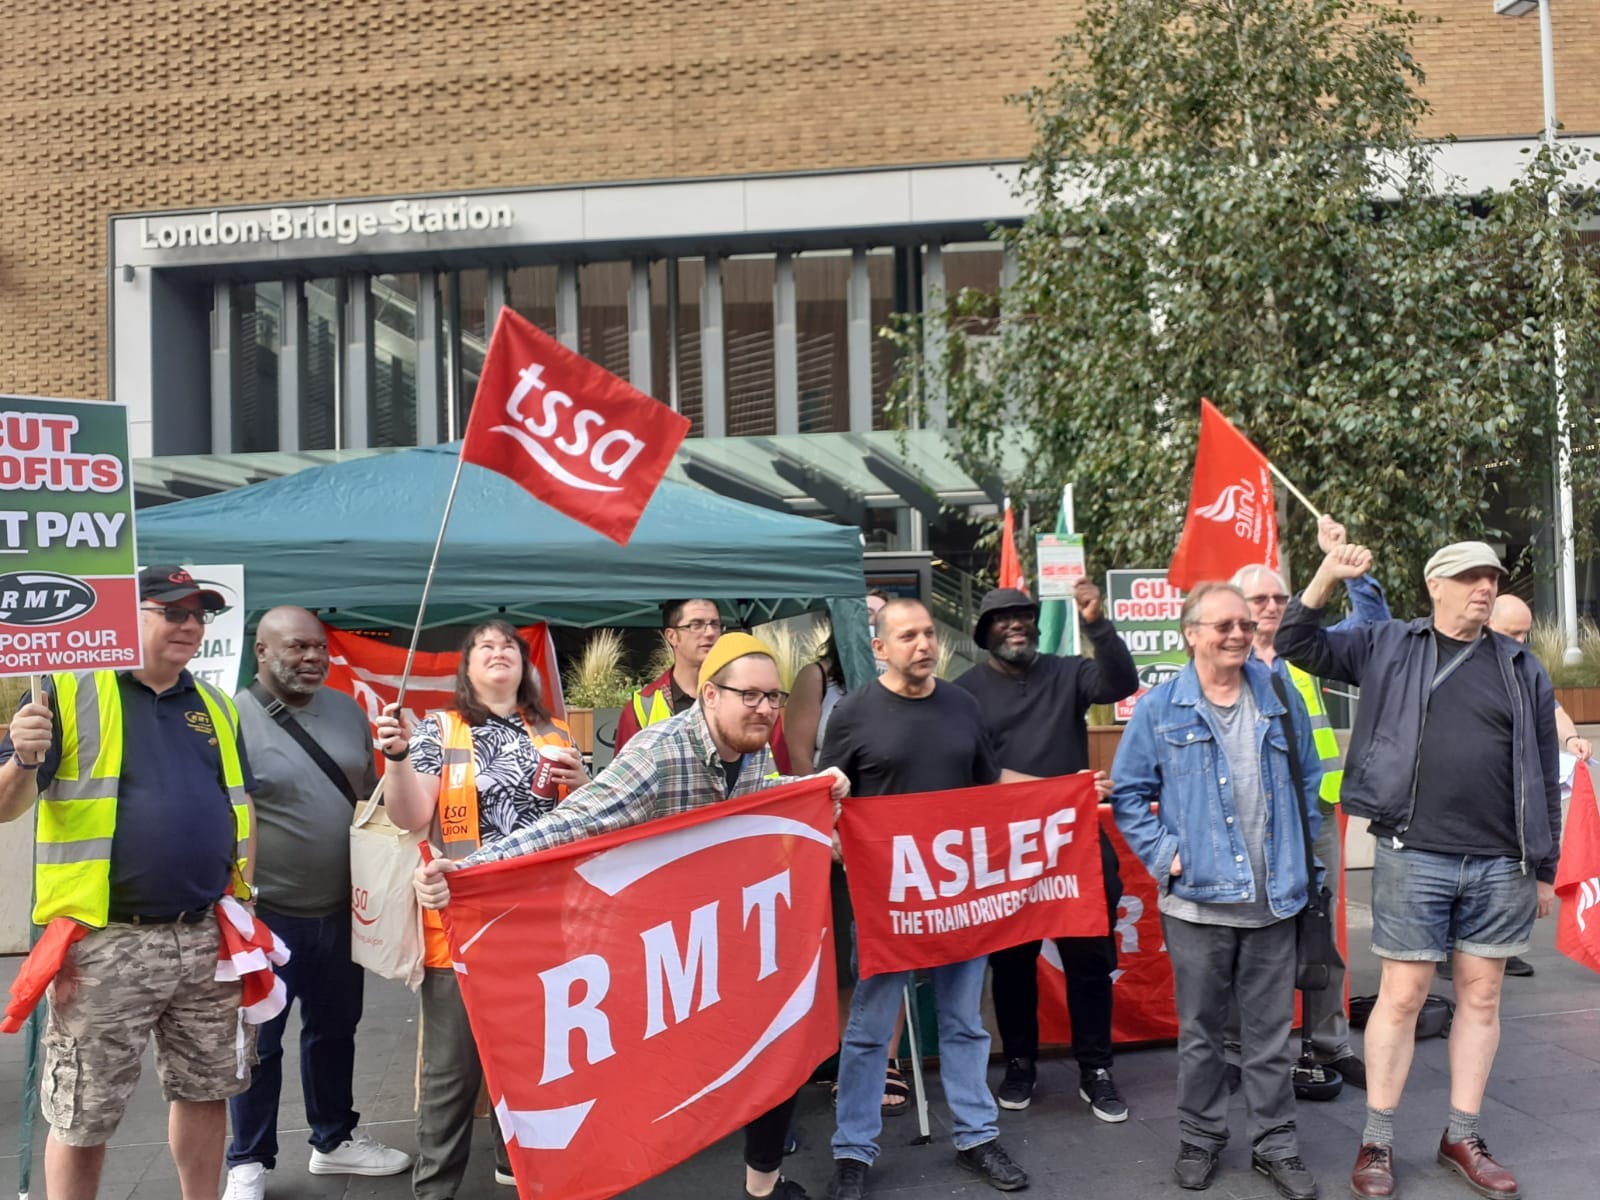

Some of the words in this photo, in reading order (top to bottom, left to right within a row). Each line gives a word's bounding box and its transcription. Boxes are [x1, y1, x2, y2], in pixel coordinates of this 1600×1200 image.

[139, 211, 261, 249] London
[269, 203, 379, 245] Bridge
[388, 197, 513, 233] Station
[0, 416, 75, 452] UT
[505, 362, 646, 481] tssa
[36, 511, 126, 548] PAY
[1, 589, 71, 609] RMT
[1116, 601, 1184, 618] PROFI
[46, 648, 135, 665] WORKERS
[67, 630, 118, 647] OUR
[536, 763, 551, 789] COSTA
[889, 808, 1077, 903] ASLEF
[889, 910, 924, 935] THE
[924, 902, 971, 934] TRAIN
[1029, 874, 1080, 903] UNION
[537, 868, 792, 1087] RMT
